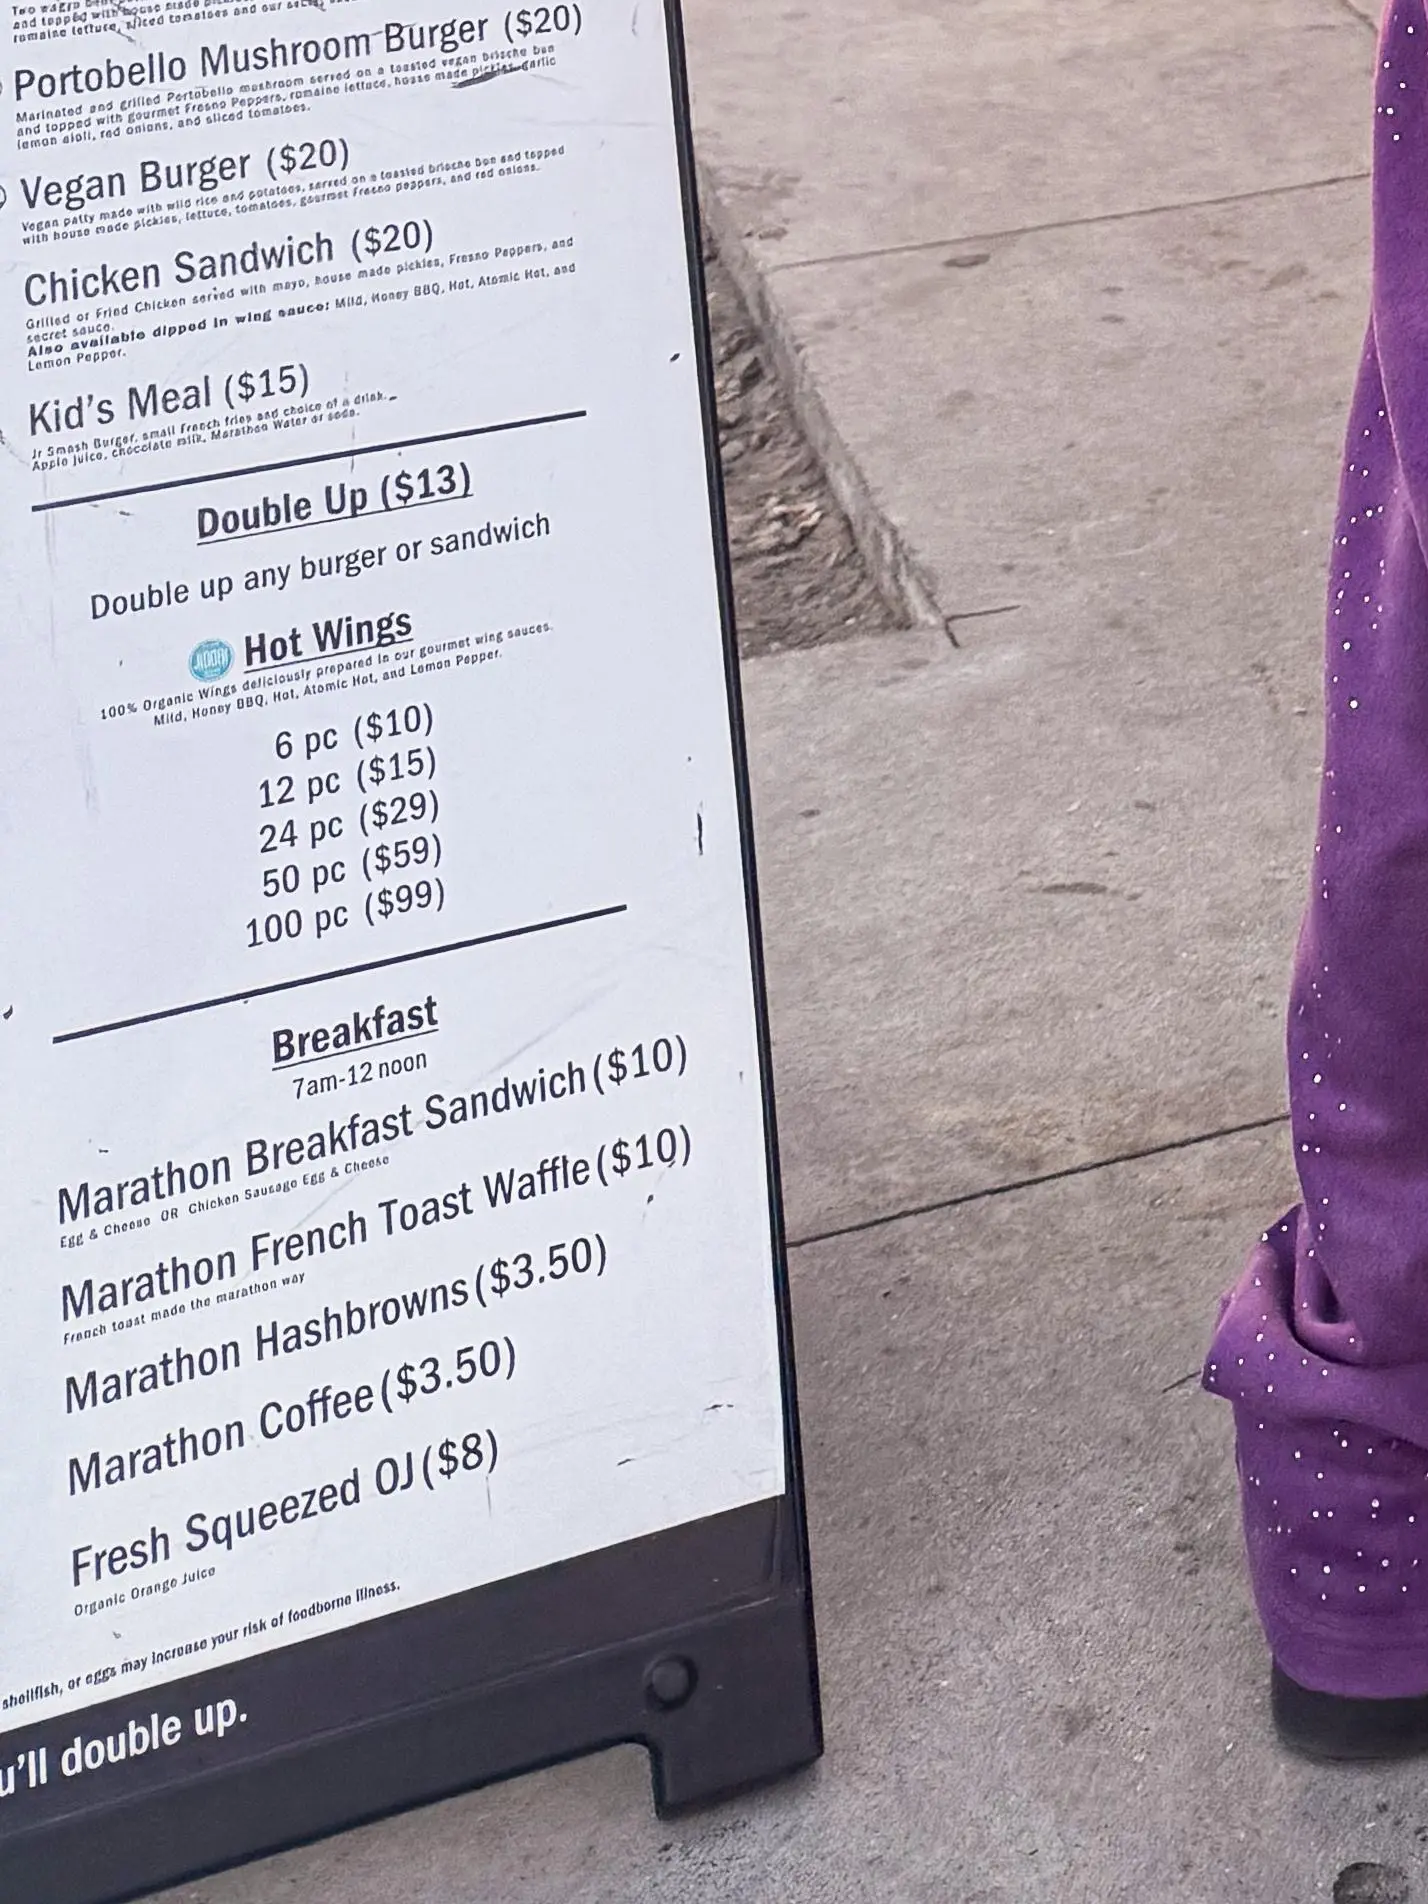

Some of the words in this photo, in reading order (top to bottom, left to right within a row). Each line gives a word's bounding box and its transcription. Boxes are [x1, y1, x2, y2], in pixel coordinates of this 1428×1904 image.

[14, 51, 187, 102] Portobello
[200, 25, 373, 80] Mushroom
[382, 18, 490, 55] Burger
[504, 3, 582, 44] ($20)
[19, 172, 126, 212] Vegan
[140, 153, 251, 193] Burger
[266, 137, 349, 182] ($20)
[24, 263, 161, 307] Chicken
[174, 231, 334, 284] Sandwich
[351, 219, 433, 264] ($20)
[29, 394, 115, 437] Kid's
[128, 374, 211, 421] Meal
[224, 363, 309, 410] ($15)
[197, 493, 312, 540] Double
[324, 483, 368, 516] Up
[380, 461, 474, 510] ($13)
[90, 580, 190, 620] Double
[200, 576, 233, 602] up
[244, 563, 291, 591] any
[300, 546, 387, 580] burger
[395, 539, 423, 562] or
[430, 512, 550, 556] sandwich
[244, 627, 304, 667] Hot
[311, 611, 412, 653] Wings
[275, 730, 293, 760] 6
[305, 728, 338, 761] pc
[354, 702, 433, 750] ($10)
[259, 775, 295, 809] 12
[307, 772, 341, 805] pc
[357, 745, 436, 794] ($15)
[259, 819, 299, 854] 24
[310, 816, 344, 850] pc
[359, 789, 439, 838] ($29)
[263, 864, 300, 898] 50
[312, 860, 346, 895] pc
[362, 832, 442, 883] ($59)
[246, 909, 303, 948] 100
[315, 905, 349, 940] pc
[365, 877, 445, 927] ($99)
[272, 995, 439, 1064] Breakfast
[292, 1061, 374, 1100] 7am-12
[378, 1052, 427, 1079] noon
[58, 1156, 231, 1225] Marathon
[246, 1104, 414, 1177] Breakfast
[425, 1060, 586, 1130] Sandwich
[593, 1034, 687, 1096] ($10)
[62, 1251, 236, 1322] Marathon
[251, 1210, 367, 1272] French
[377, 1182, 474, 1236] Toast
[482, 1154, 590, 1209] Waffle
[597, 1124, 691, 1187] ($10)
[65, 1340, 241, 1414] Marathon
[256, 1279, 469, 1362] Hashbrowns
[475, 1233, 607, 1308] ($3.50)
[69, 1420, 245, 1497] Marathon
[260, 1384, 374, 1440] Coffee
[381, 1336, 516, 1414] ($3.50)
[72, 1526, 170, 1588] Fresh
[185, 1467, 361, 1552] Squeezed
[375, 1451, 414, 1496] OJ
[422, 1428, 498, 1491] ($8)
[61, 1712, 182, 1777] double
[194, 1698, 248, 1738] up.
